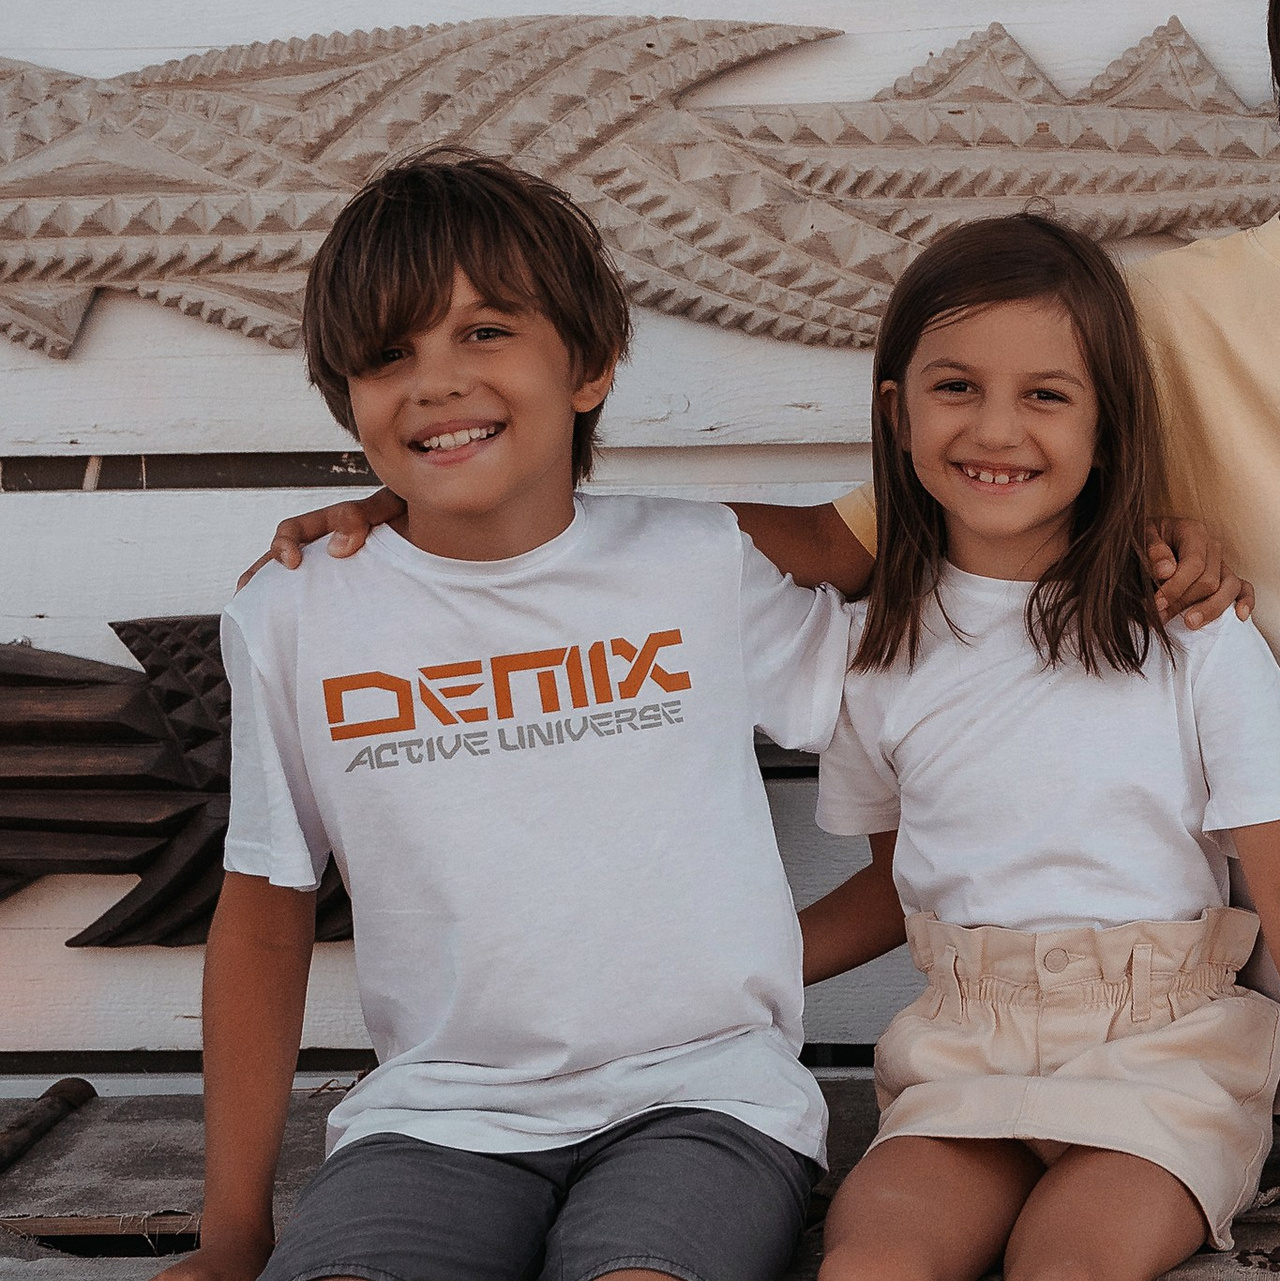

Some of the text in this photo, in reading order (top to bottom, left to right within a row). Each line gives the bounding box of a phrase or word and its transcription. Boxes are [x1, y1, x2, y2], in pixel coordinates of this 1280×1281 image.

[321, 628, 693, 742] DEMIX
[344, 699, 685, 773] ACTIVE UNIVERSE
